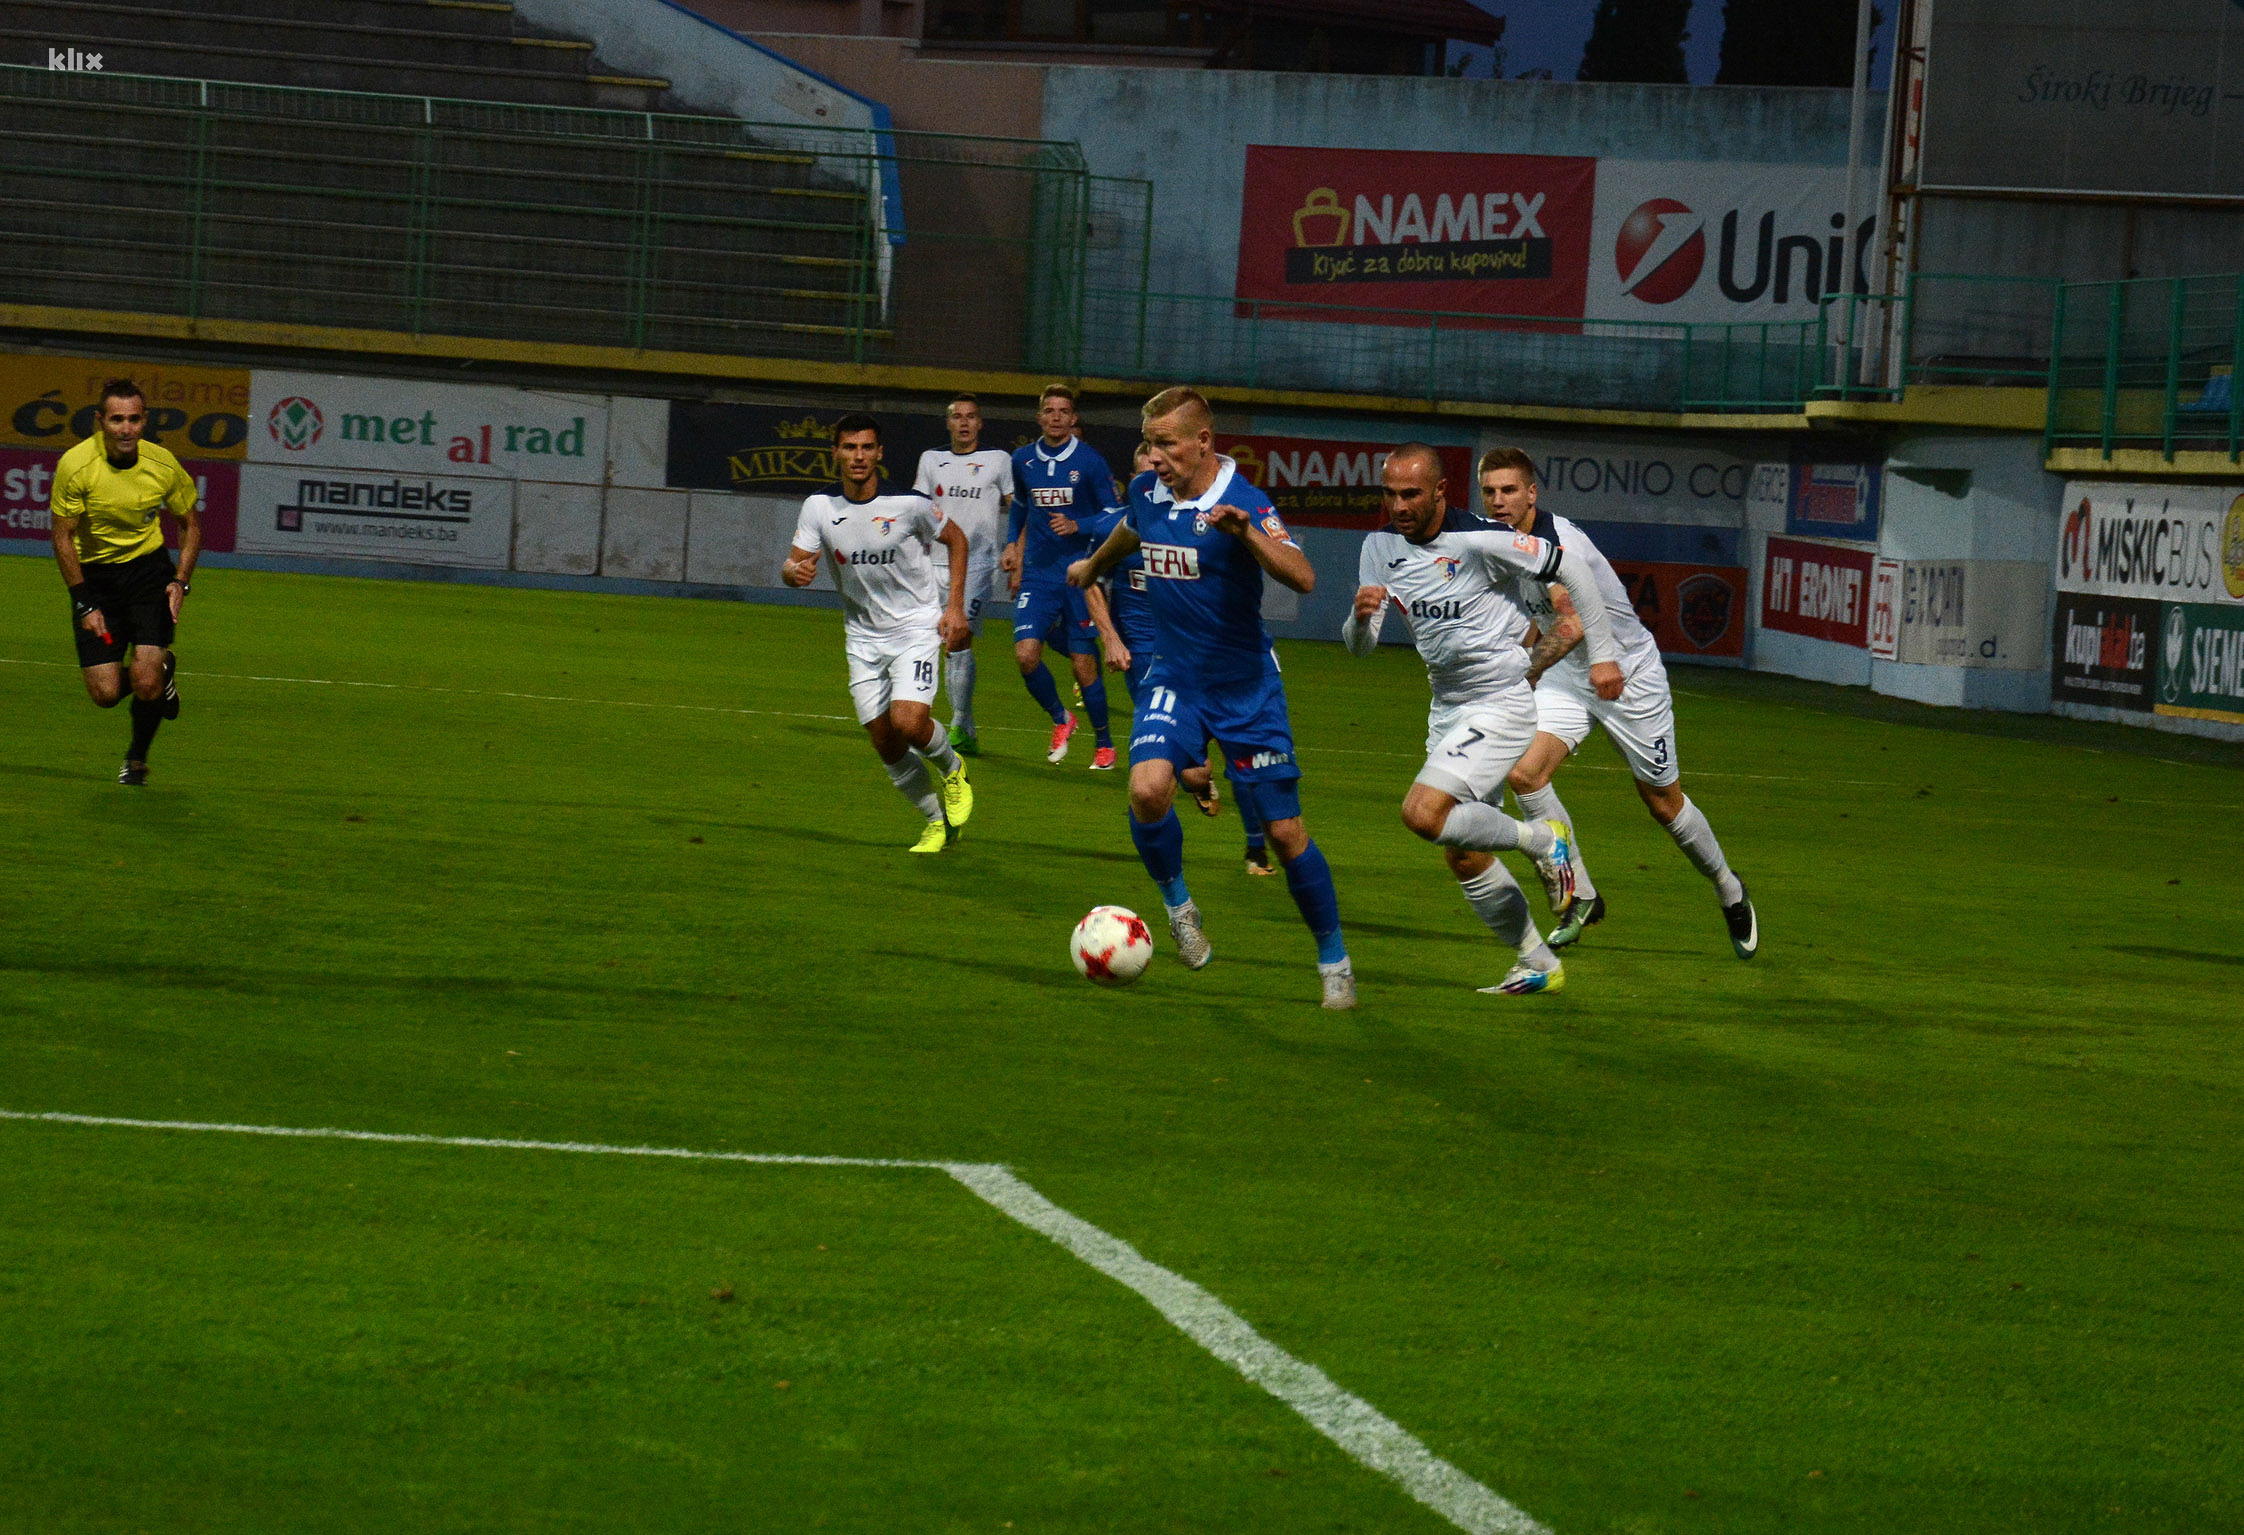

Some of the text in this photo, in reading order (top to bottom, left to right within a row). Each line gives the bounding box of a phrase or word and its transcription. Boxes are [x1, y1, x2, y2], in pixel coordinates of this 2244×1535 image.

[2018, 64, 2213, 116] Široki Brijeg
[1353, 192, 1546, 246] NAMEX
[1363, 257, 1391, 275] za
[1397, 249, 1444, 273] dobru
[1533, 456, 1674, 496] NTONIO
[299, 479, 473, 513] mandeks
[314, 520, 458, 542] www.mandeks.ba
[1017, 591, 1031, 609] 5
[1800, 559, 1863, 626] ERONET
[968, 598, 981, 617] 9
[913, 660, 933, 684] 18
[1149, 685, 1177, 714] 11
[1460, 727, 1486, 751] 7
